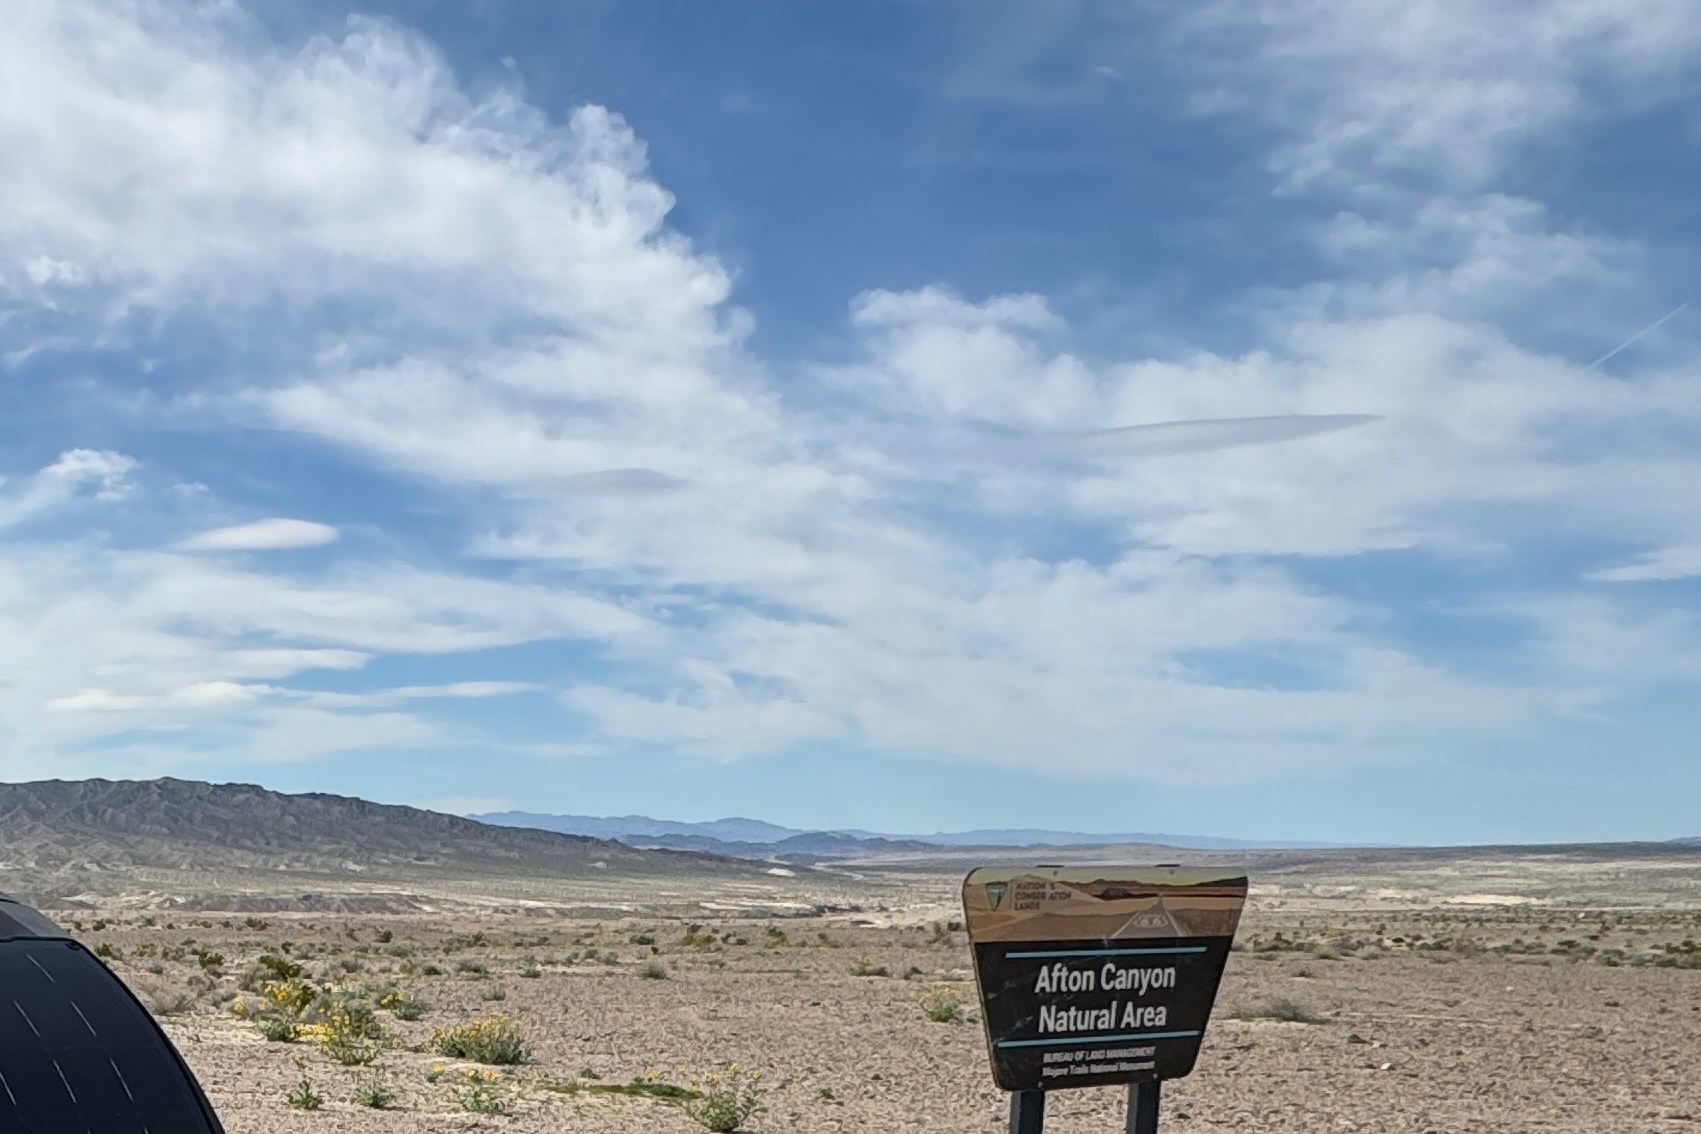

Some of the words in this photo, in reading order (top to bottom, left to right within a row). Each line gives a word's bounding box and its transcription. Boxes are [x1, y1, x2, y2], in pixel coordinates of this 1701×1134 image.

[1014, 891, 1072, 901] CONSERATION
[1015, 881, 1057, 890] NATIONL
[1034, 963, 1095, 993] Afton
[1100, 963, 1176, 997] Canyon
[1038, 1001, 1118, 1033] Natural
[1120, 1001, 1168, 1028] Area
